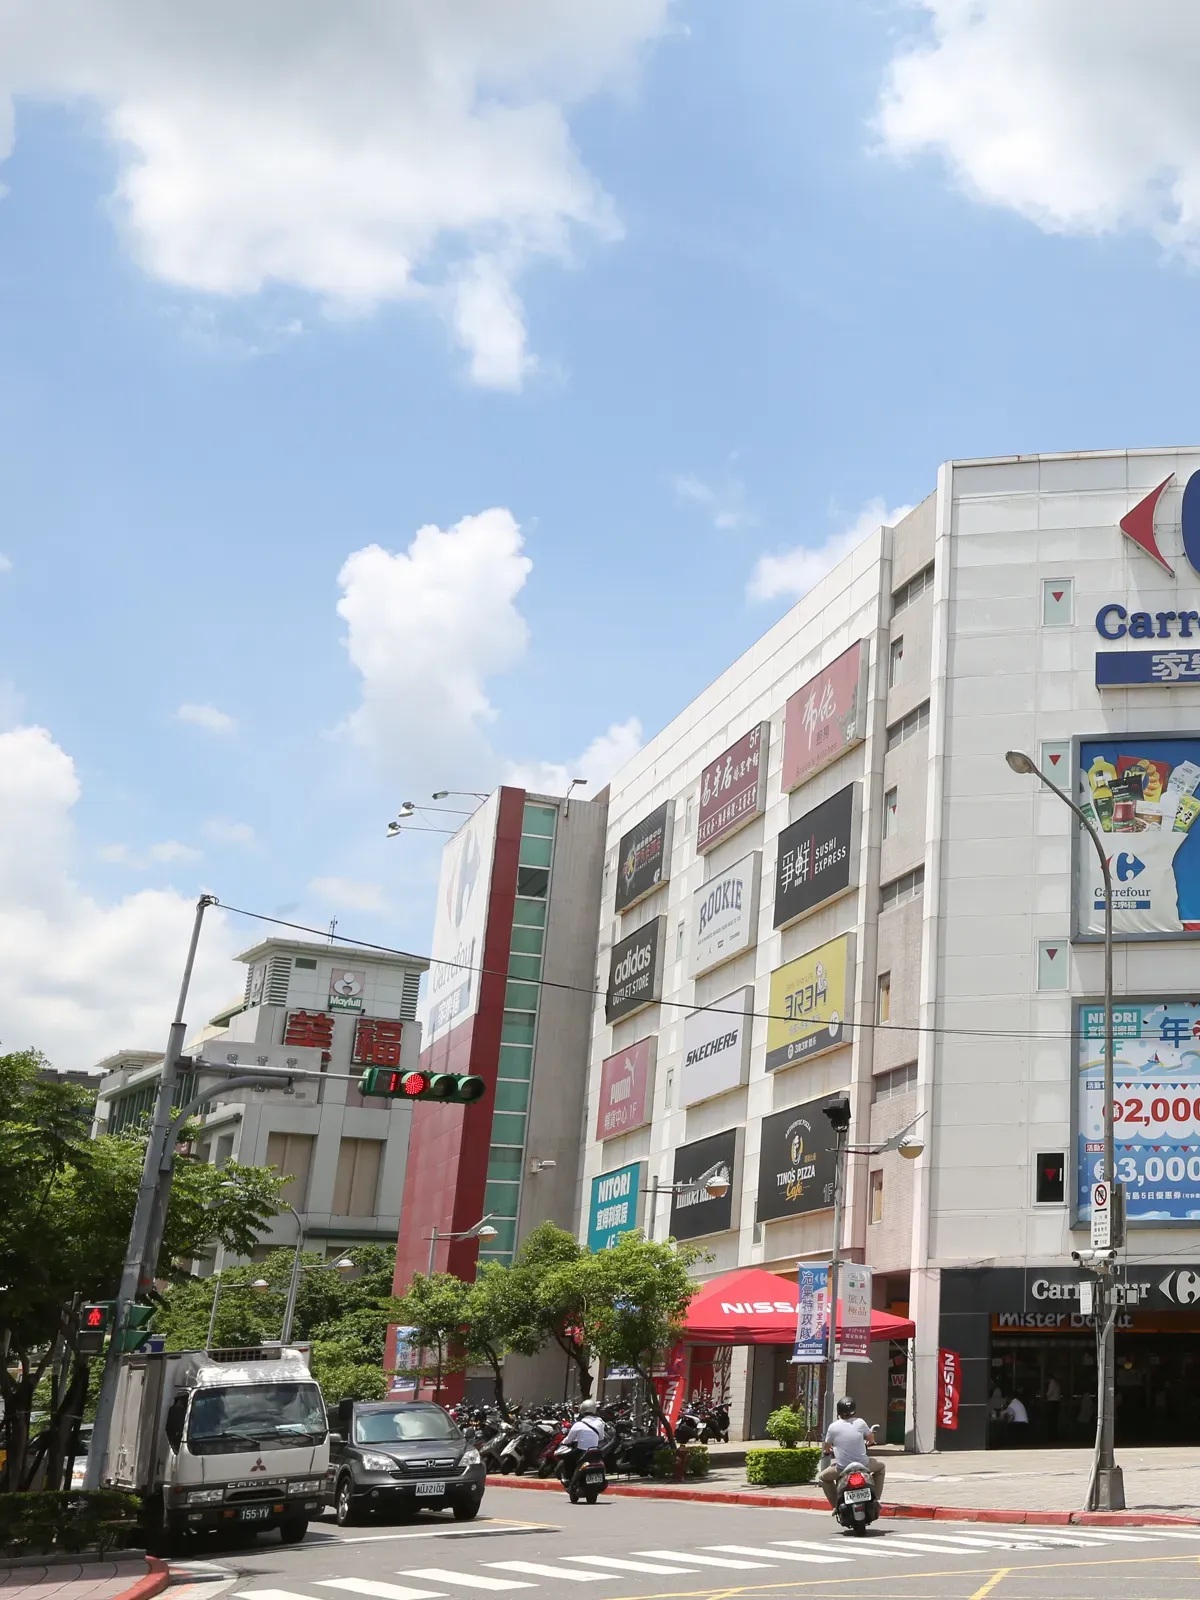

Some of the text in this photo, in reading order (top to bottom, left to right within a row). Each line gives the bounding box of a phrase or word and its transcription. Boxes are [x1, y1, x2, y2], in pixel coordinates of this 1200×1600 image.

[749, 726, 759, 748] 5F
[815, 837, 837, 857] SUSHI
[814, 845, 846, 875] EXPRESS
[699, 878, 743, 935] ROOKIE
[615, 944, 651, 985] adidas
[632, 972, 649, 994] STORE
[330, 995, 361, 1007] Mayfull
[1088, 1012, 1137, 1024] NIORI
[685, 1028, 739, 1068] SKECHERS
[610, 1076, 631, 1106] PUMA
[598, 1171, 631, 1203] NITORI
[777, 1165, 816, 1187] TINO'S PIZZA
[596, 1202, 629, 1231] 宜得利家居
[1032, 1279, 1150, 1299] Carrr
[721, 1302, 831, 1314] NISS
[1000, 1312, 1134, 1328] Mister Dout
[942, 1353, 956, 1426] NISSAN
[227, 1478, 287, 1488] CANTER
